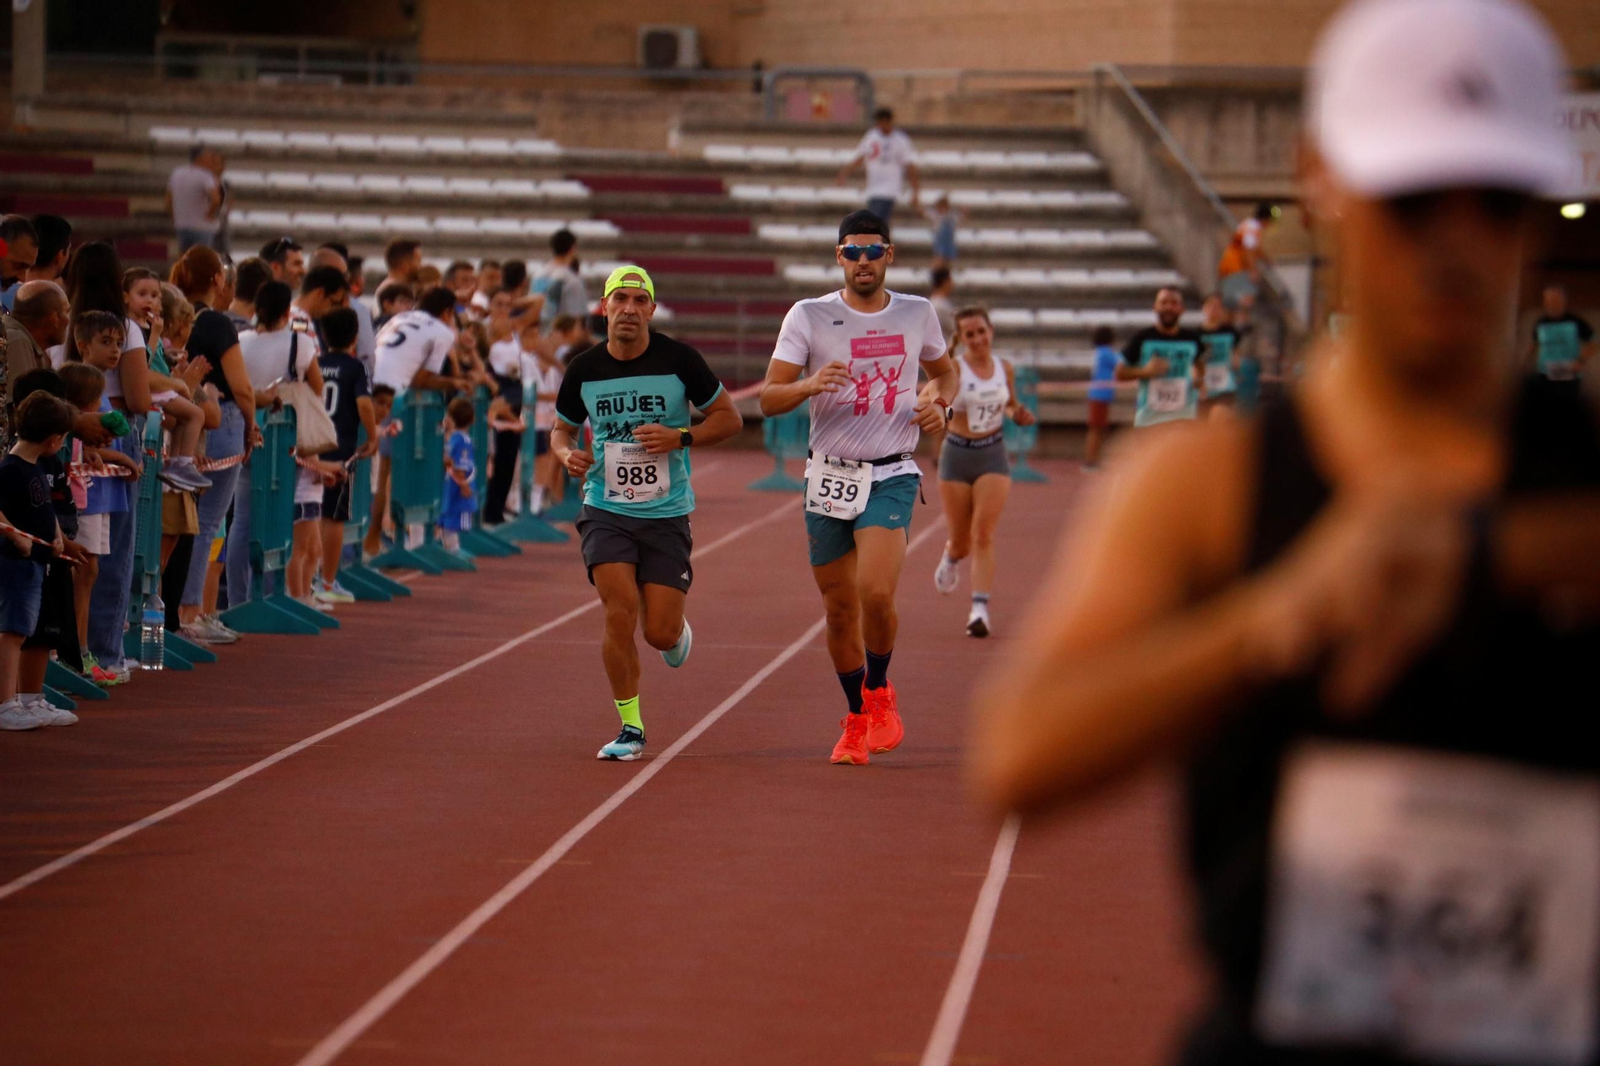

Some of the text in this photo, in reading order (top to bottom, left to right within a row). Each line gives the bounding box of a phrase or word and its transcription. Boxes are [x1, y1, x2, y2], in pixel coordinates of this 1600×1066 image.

[596, 395, 667, 417] MUJER
[616, 464, 658, 486] 988
[818, 478, 859, 503] 539
